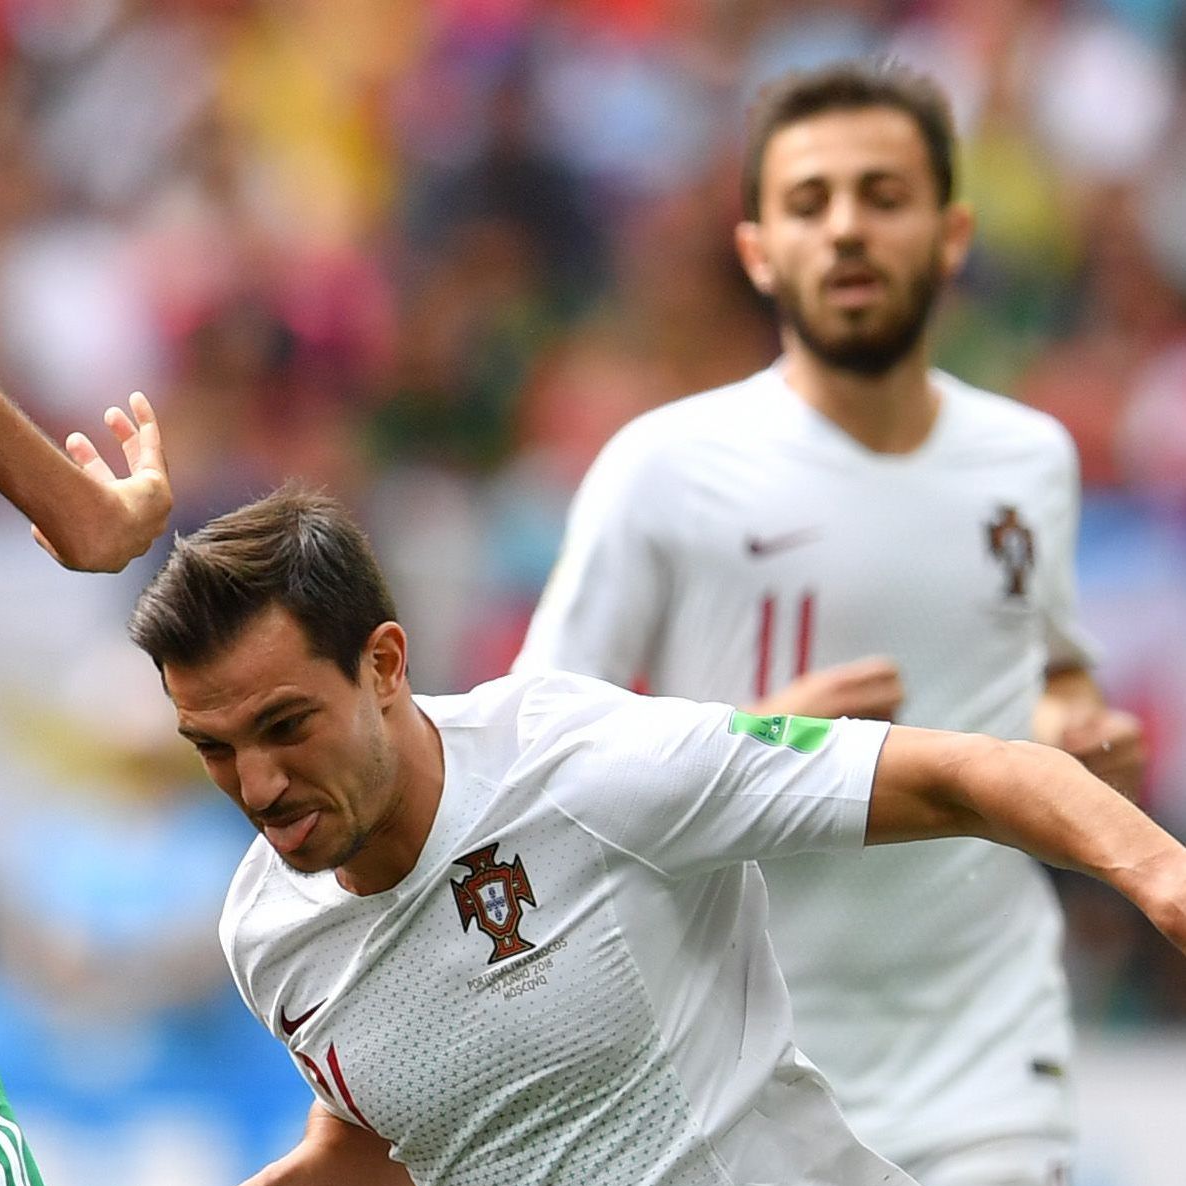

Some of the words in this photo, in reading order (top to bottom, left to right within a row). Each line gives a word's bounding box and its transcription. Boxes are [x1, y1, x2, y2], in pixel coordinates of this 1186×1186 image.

[754, 590, 814, 700] 11
[531, 958, 554, 976] 2018
[503, 974, 547, 1001] MOSCOVO
